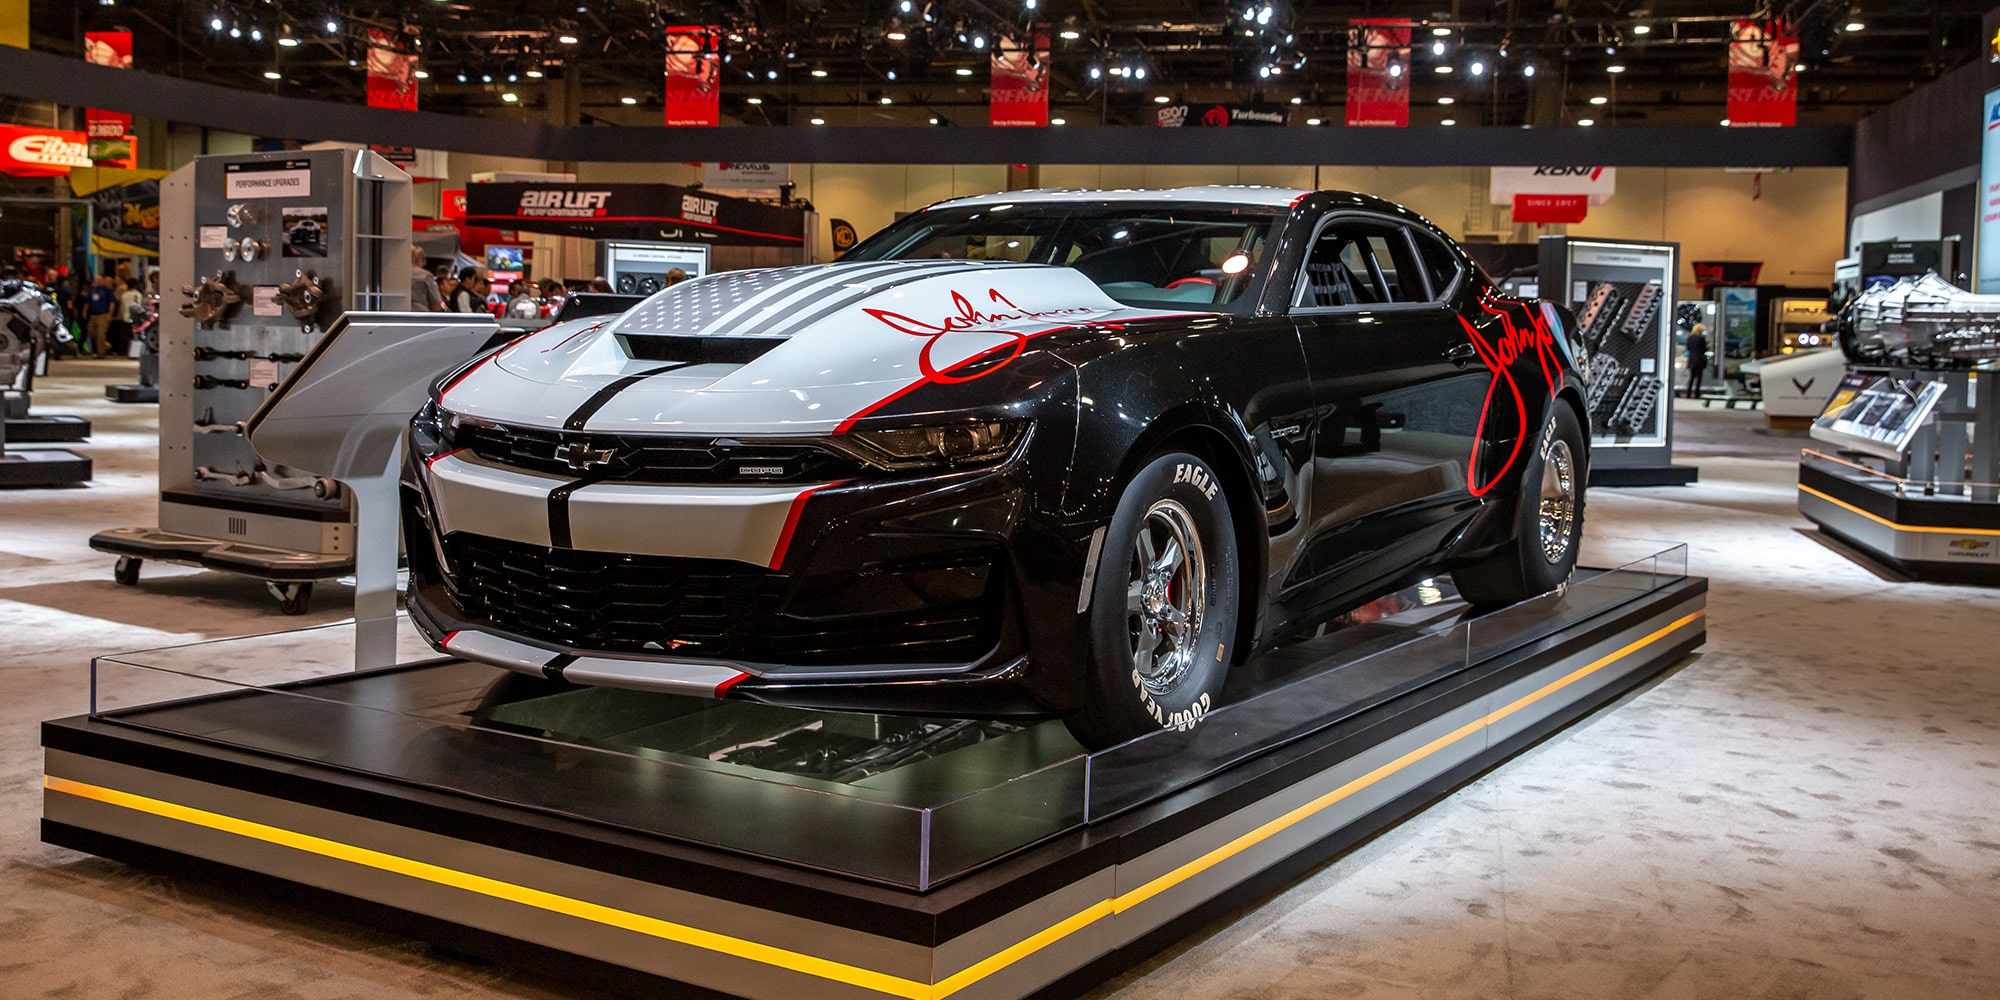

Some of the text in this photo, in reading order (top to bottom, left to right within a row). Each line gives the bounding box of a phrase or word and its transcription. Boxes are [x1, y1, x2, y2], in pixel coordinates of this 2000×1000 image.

[235, 177, 300, 188] PERFORMANCE UPGRADES
[564, 191, 612, 208] LIFT
[700, 198, 719, 216] LIFT
[1540, 416, 1557, 460] EAGLE
[1173, 463, 1218, 501] EAGLE
